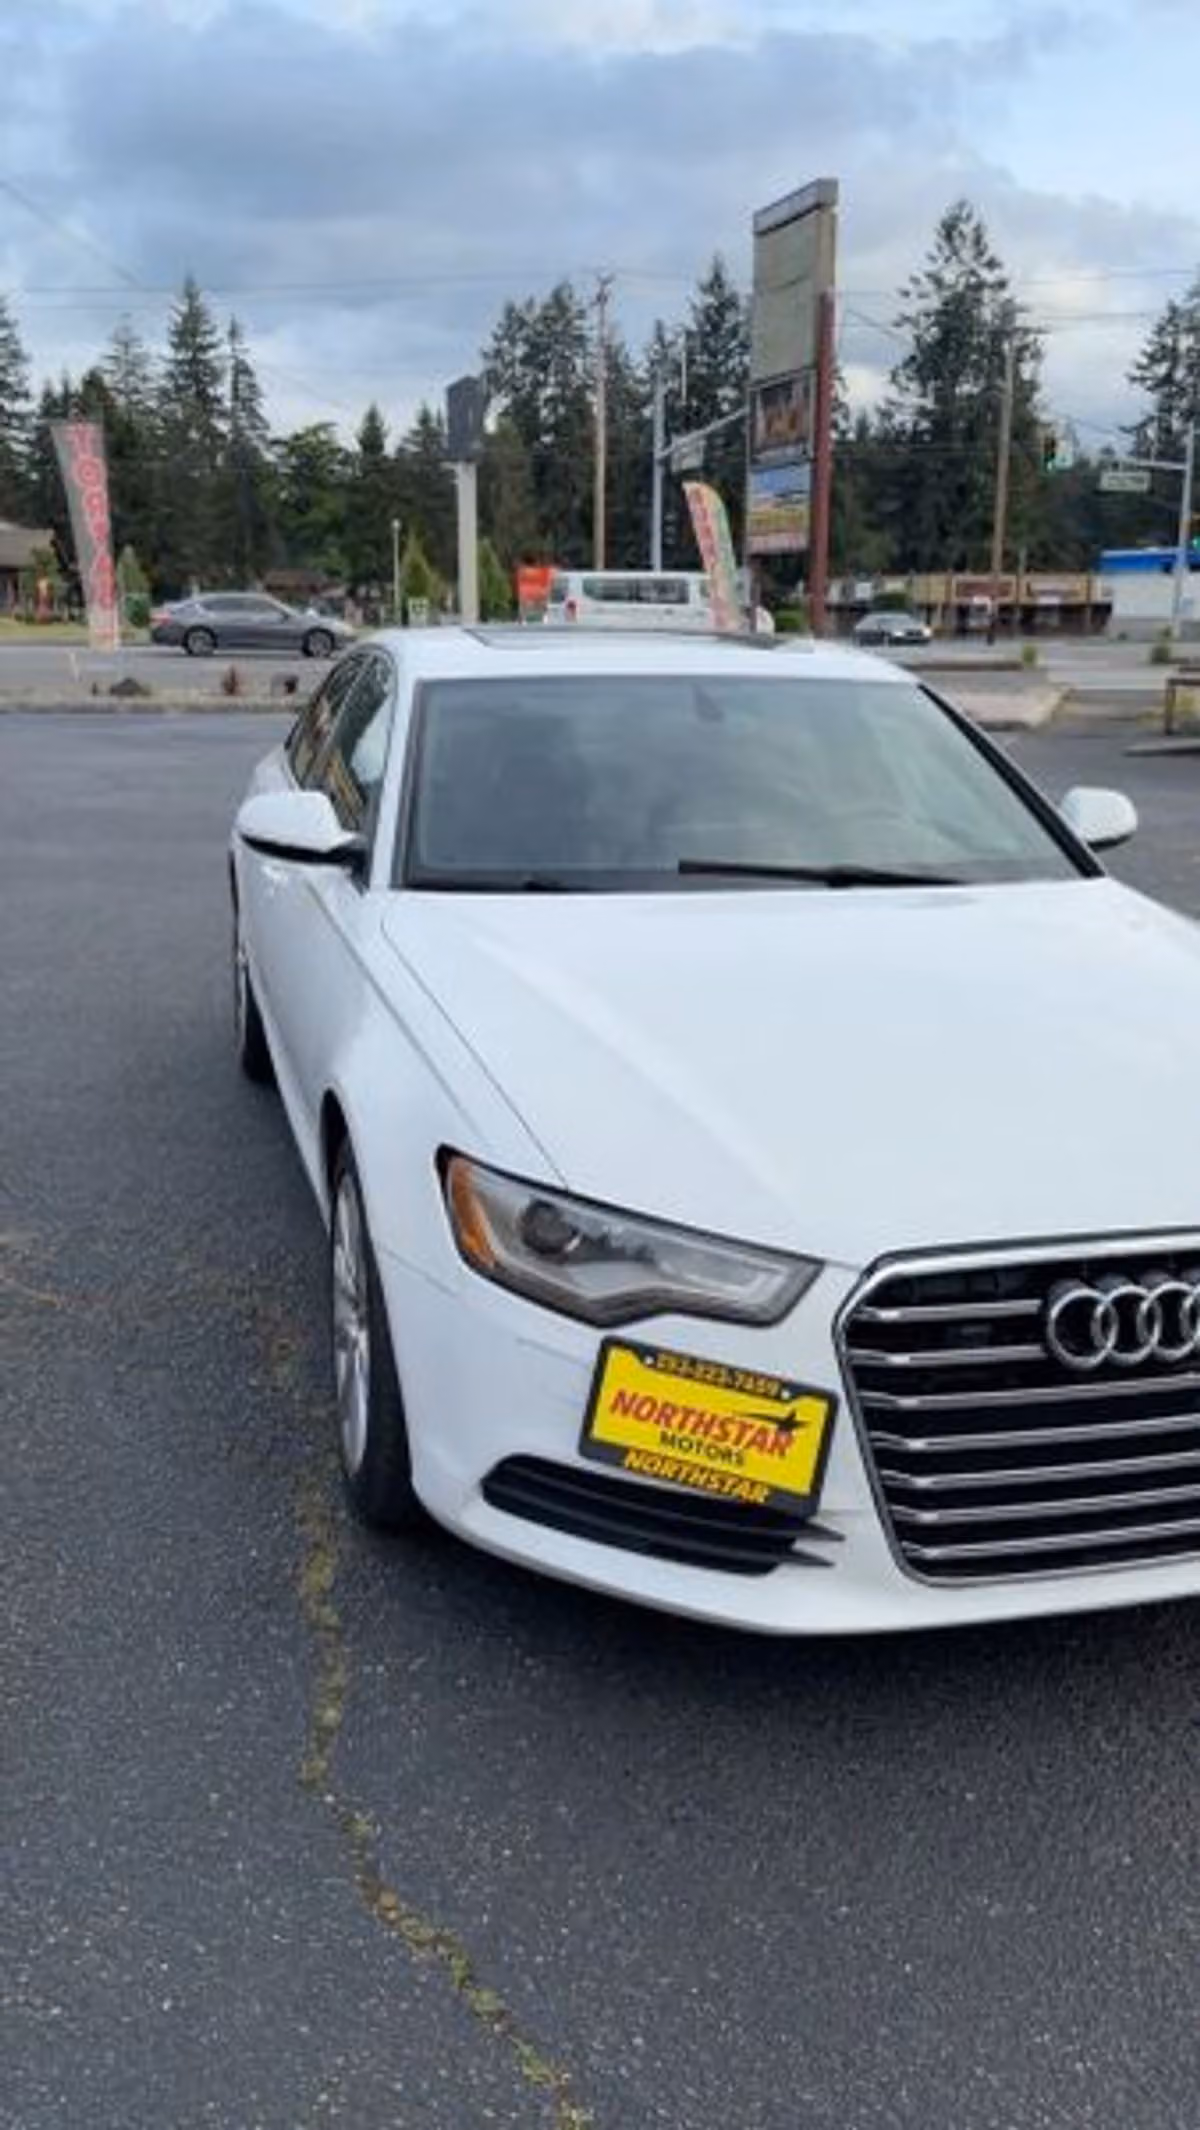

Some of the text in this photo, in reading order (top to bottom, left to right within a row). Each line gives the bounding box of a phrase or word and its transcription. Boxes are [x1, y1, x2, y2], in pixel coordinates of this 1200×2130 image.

[610, 1388, 796, 1457] NORTHSTAR
[660, 1431, 745, 1466] MOTORS
[624, 1449, 769, 1503] NORTHSTAR
